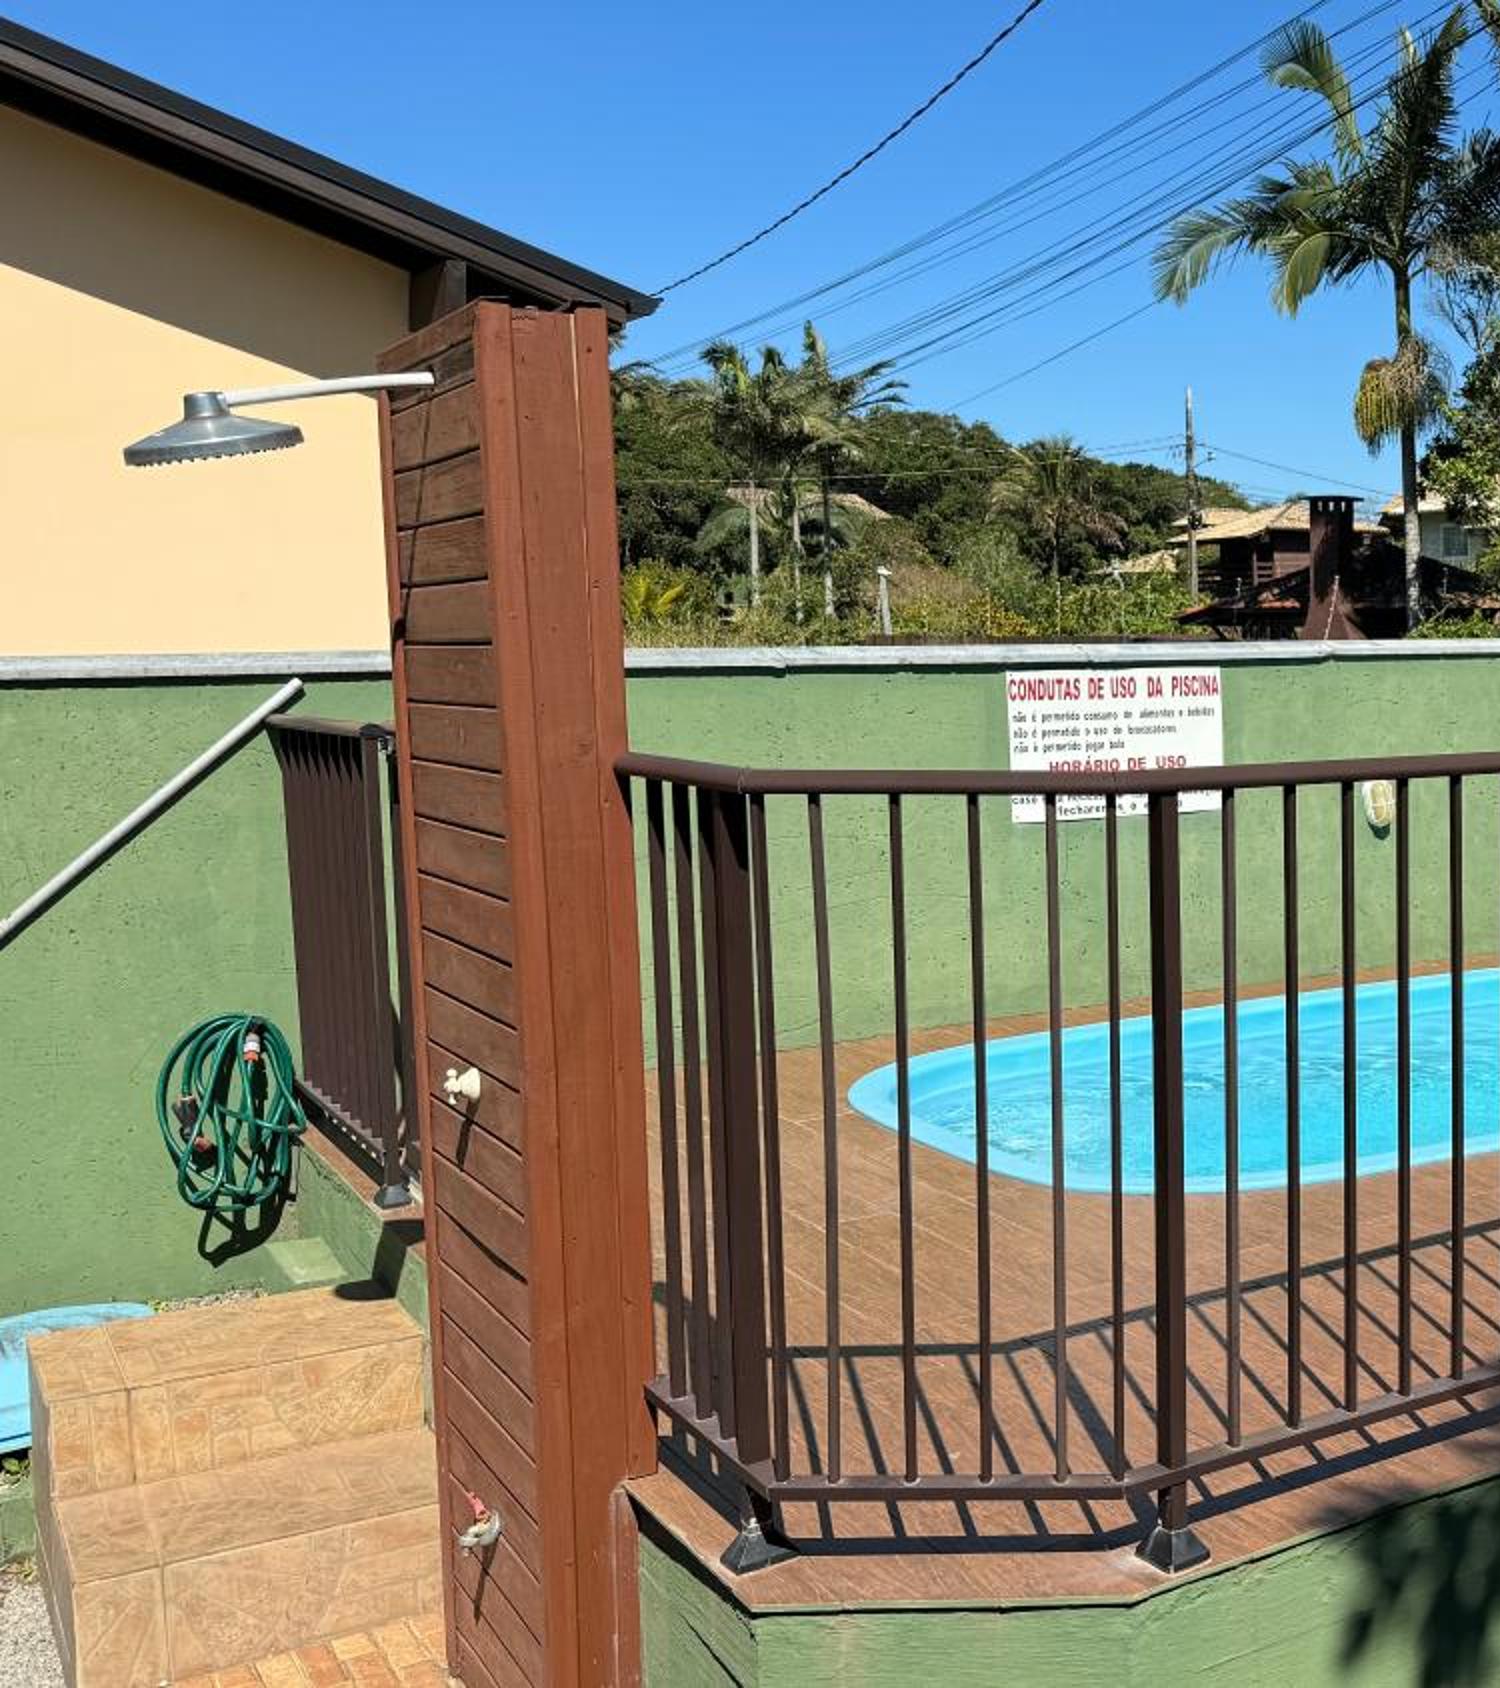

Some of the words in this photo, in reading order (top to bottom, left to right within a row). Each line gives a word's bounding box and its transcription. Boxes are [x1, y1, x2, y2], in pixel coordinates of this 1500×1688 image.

[1008, 678, 1080, 701] CONDUTAS
[1088, 677, 1104, 700] DE
[1111, 676, 1136, 698] USO
[1147, 676, 1162, 698] DA
[1171, 674, 1218, 697] PISCINA
[1049, 755, 1119, 773] HORÁRIO
[1128, 757, 1146, 771] DE
[1155, 755, 1186, 769] USO
